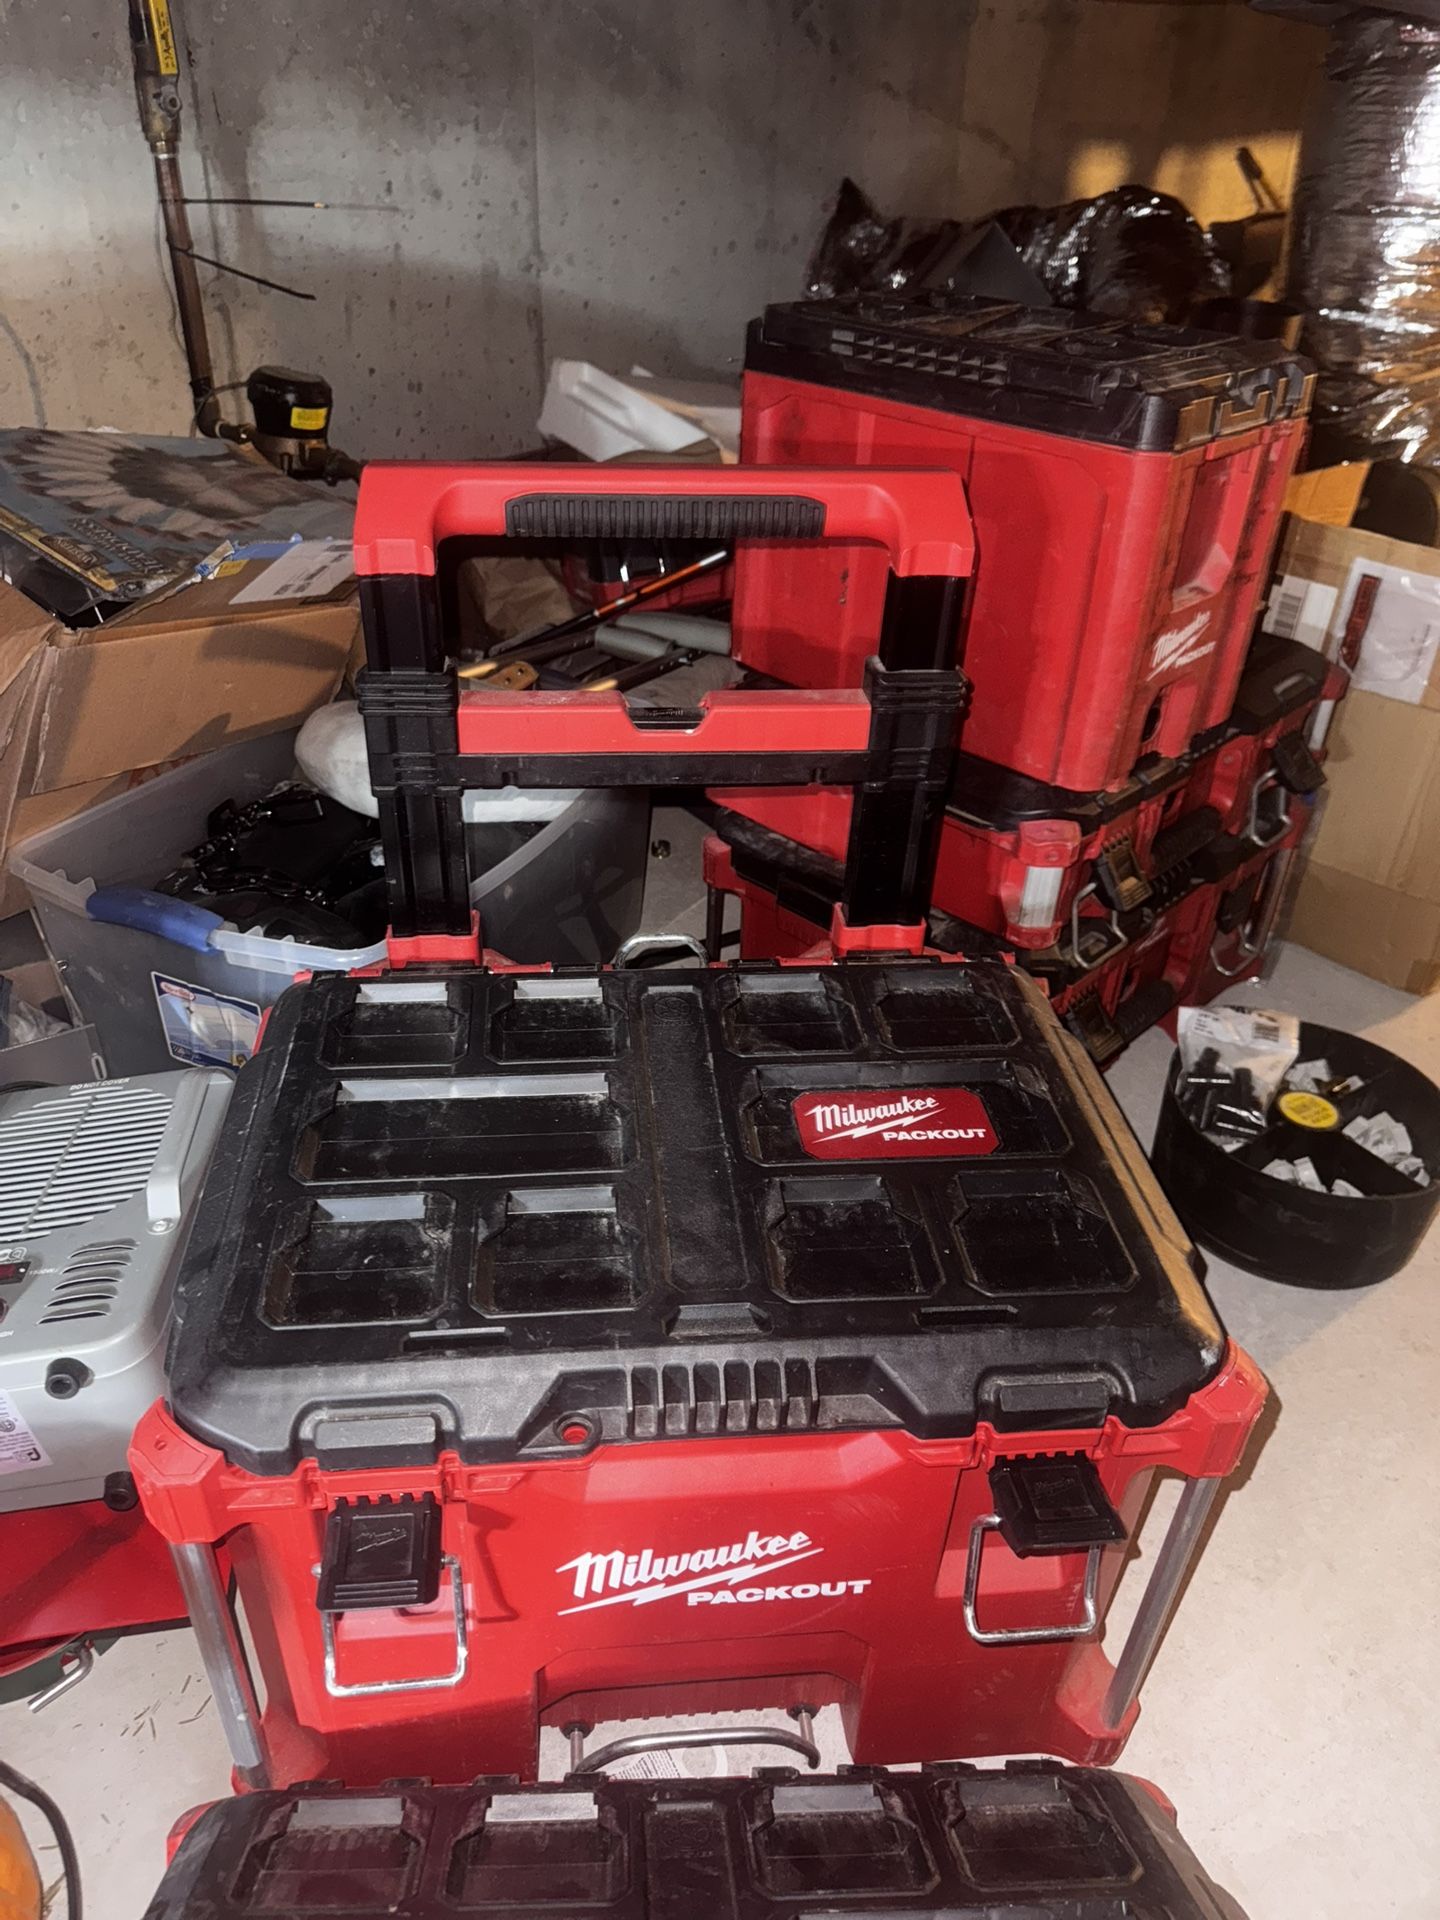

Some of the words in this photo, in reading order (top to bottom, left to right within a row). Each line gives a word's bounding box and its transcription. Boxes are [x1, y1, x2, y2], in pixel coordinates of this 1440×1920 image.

[83, 1081, 101, 1089] NOT
[101, 1078, 130, 1087] COVER
[804, 1096, 939, 1132] Milwaukee
[883, 1128, 986, 1142] PACKOUT
[555, 1531, 812, 1598] Milwaukee
[687, 1579, 872, 1606] PACKOUT
